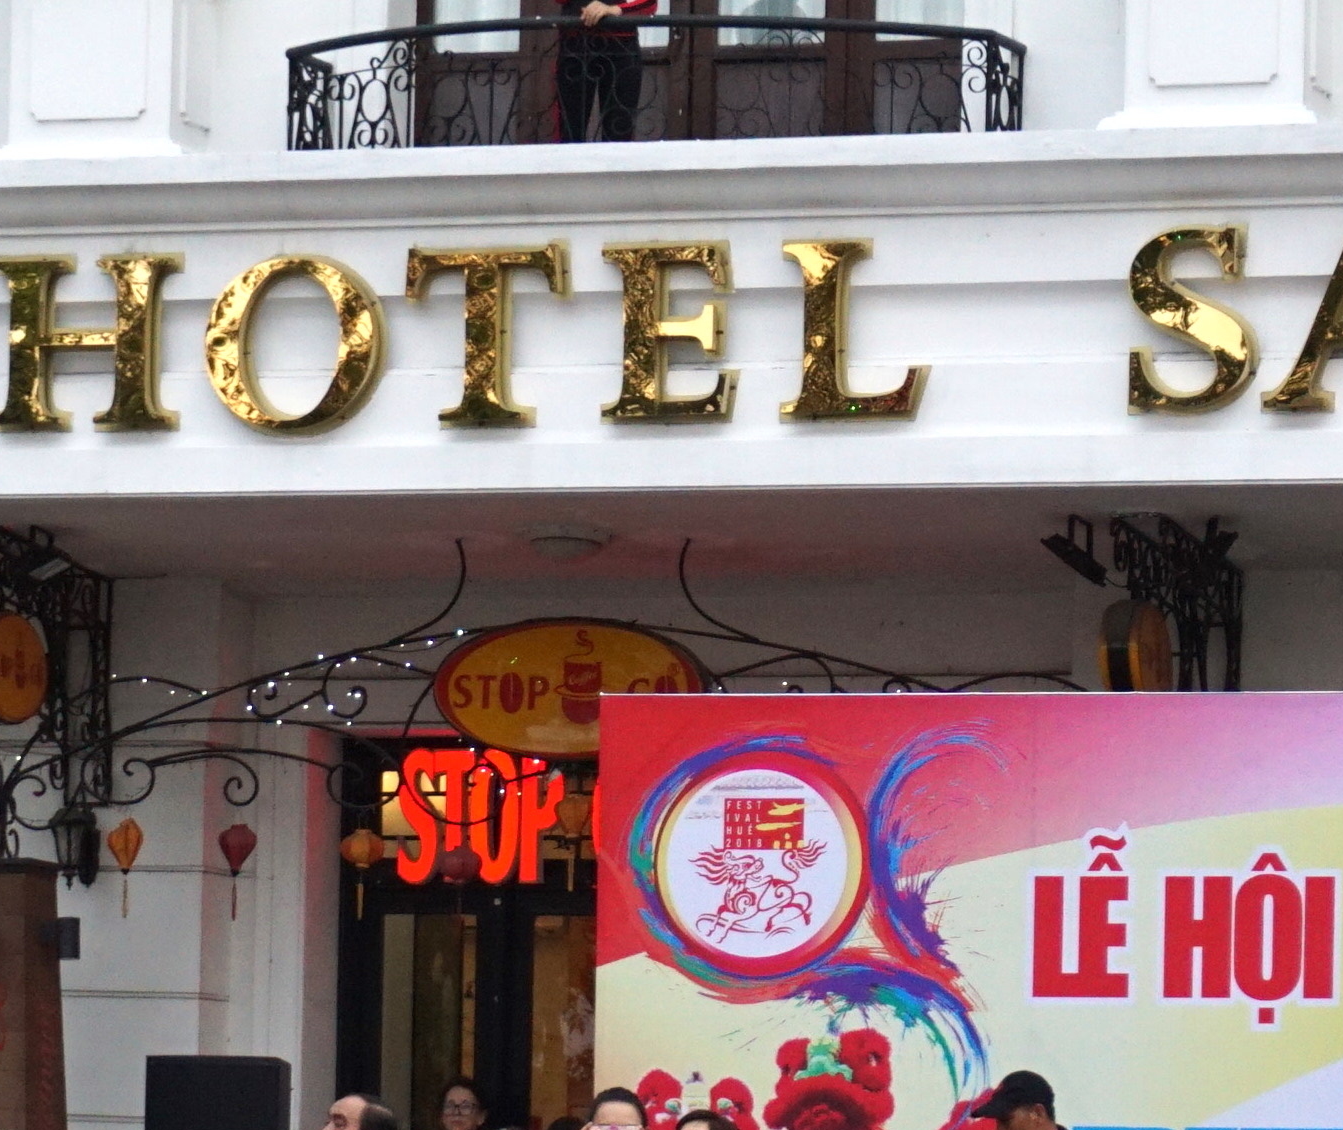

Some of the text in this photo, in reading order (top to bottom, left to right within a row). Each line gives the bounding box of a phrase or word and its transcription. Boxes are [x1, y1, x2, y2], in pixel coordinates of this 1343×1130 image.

[453, 671, 551, 714] STOP
[396, 747, 566, 885] STOP
[725, 838, 763, 848] 2018
[1033, 834, 1130, 1000] LỄ
[1163, 853, 1336, 1025] HỘI
